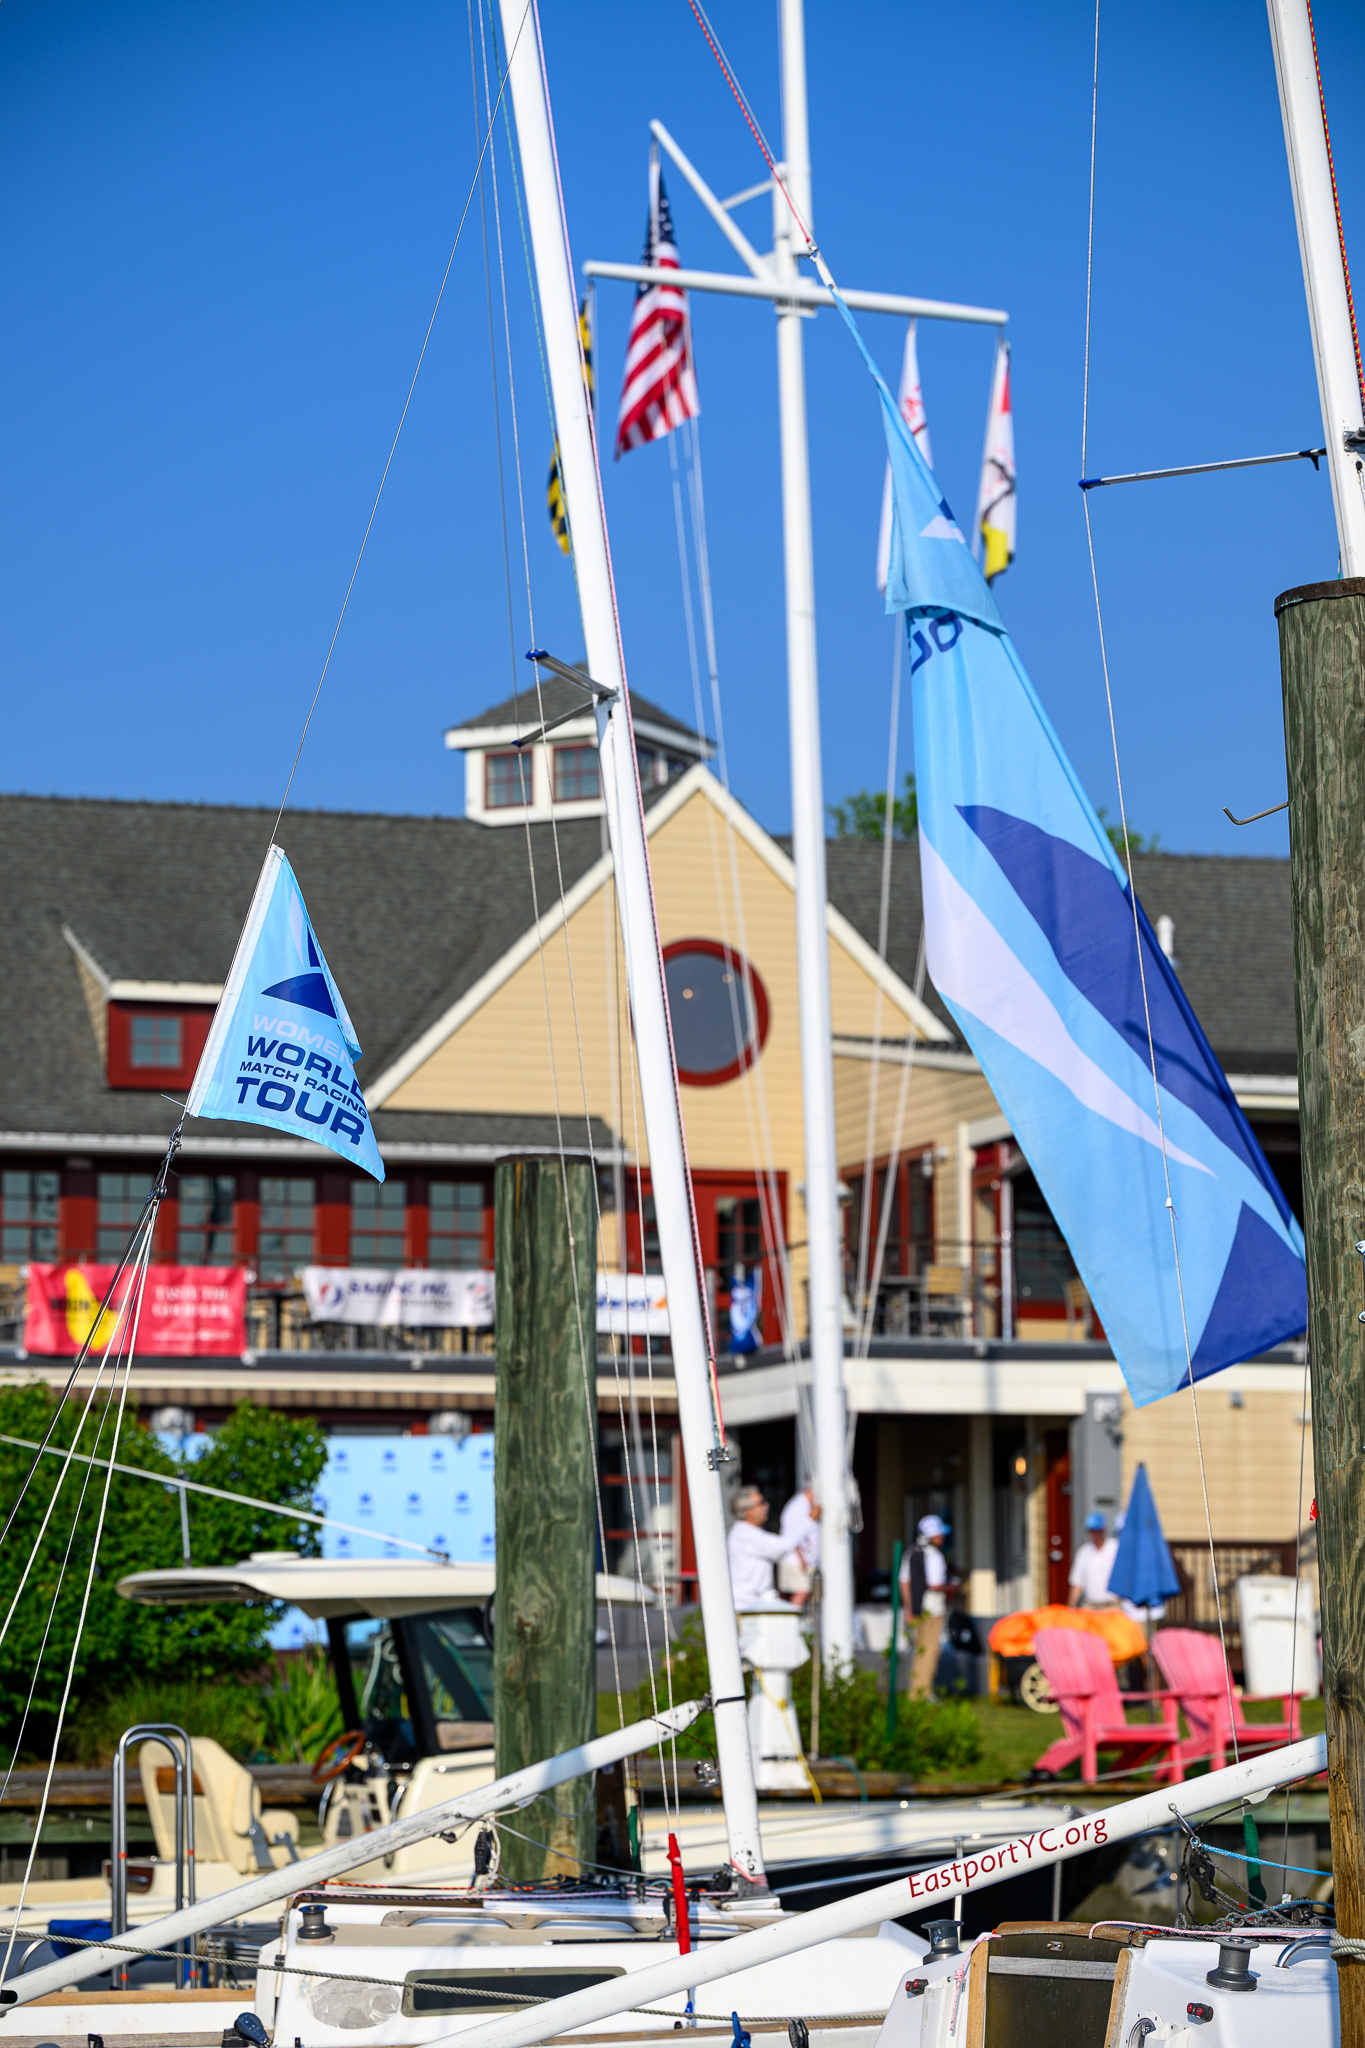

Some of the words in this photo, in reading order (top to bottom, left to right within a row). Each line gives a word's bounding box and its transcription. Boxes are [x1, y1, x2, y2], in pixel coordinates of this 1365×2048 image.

[235, 1076, 365, 1146] TOUR
[239, 1061, 299, 1083] MATCH
[304, 1076, 368, 1120] RACING
[908, 1818, 1108, 1898] EastportYC.org
